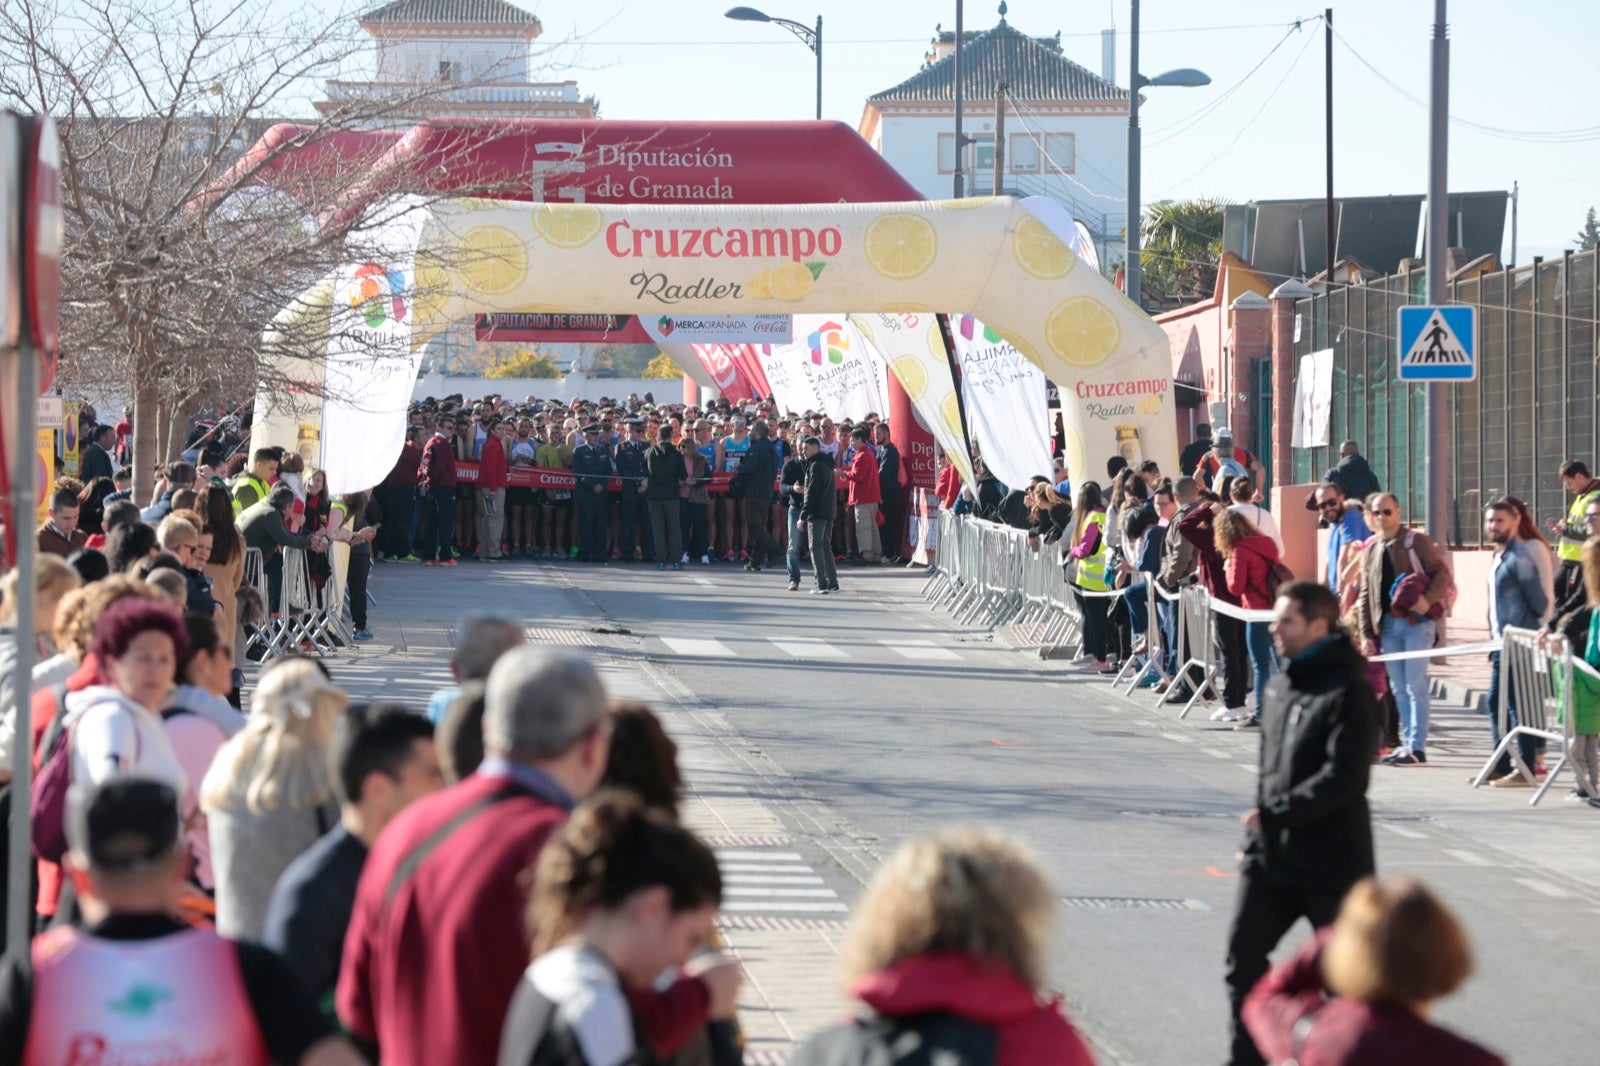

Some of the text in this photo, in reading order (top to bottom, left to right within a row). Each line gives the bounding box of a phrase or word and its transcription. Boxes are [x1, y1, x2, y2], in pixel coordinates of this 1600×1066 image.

[596, 144, 734, 171] Diputación
[596, 176, 734, 199] de Granada
[605, 219, 842, 261] Cruzcampo
[629, 269, 745, 304] Radler
[553, 314, 566, 328] DE
[569, 314, 618, 329] GRANADA
[675, 320, 747, 329] MERCAGRANADA
[1076, 378, 1168, 399] Cruzcampo
[1086, 403, 1136, 420] Radler
[540, 473, 576, 485] Cruzca
